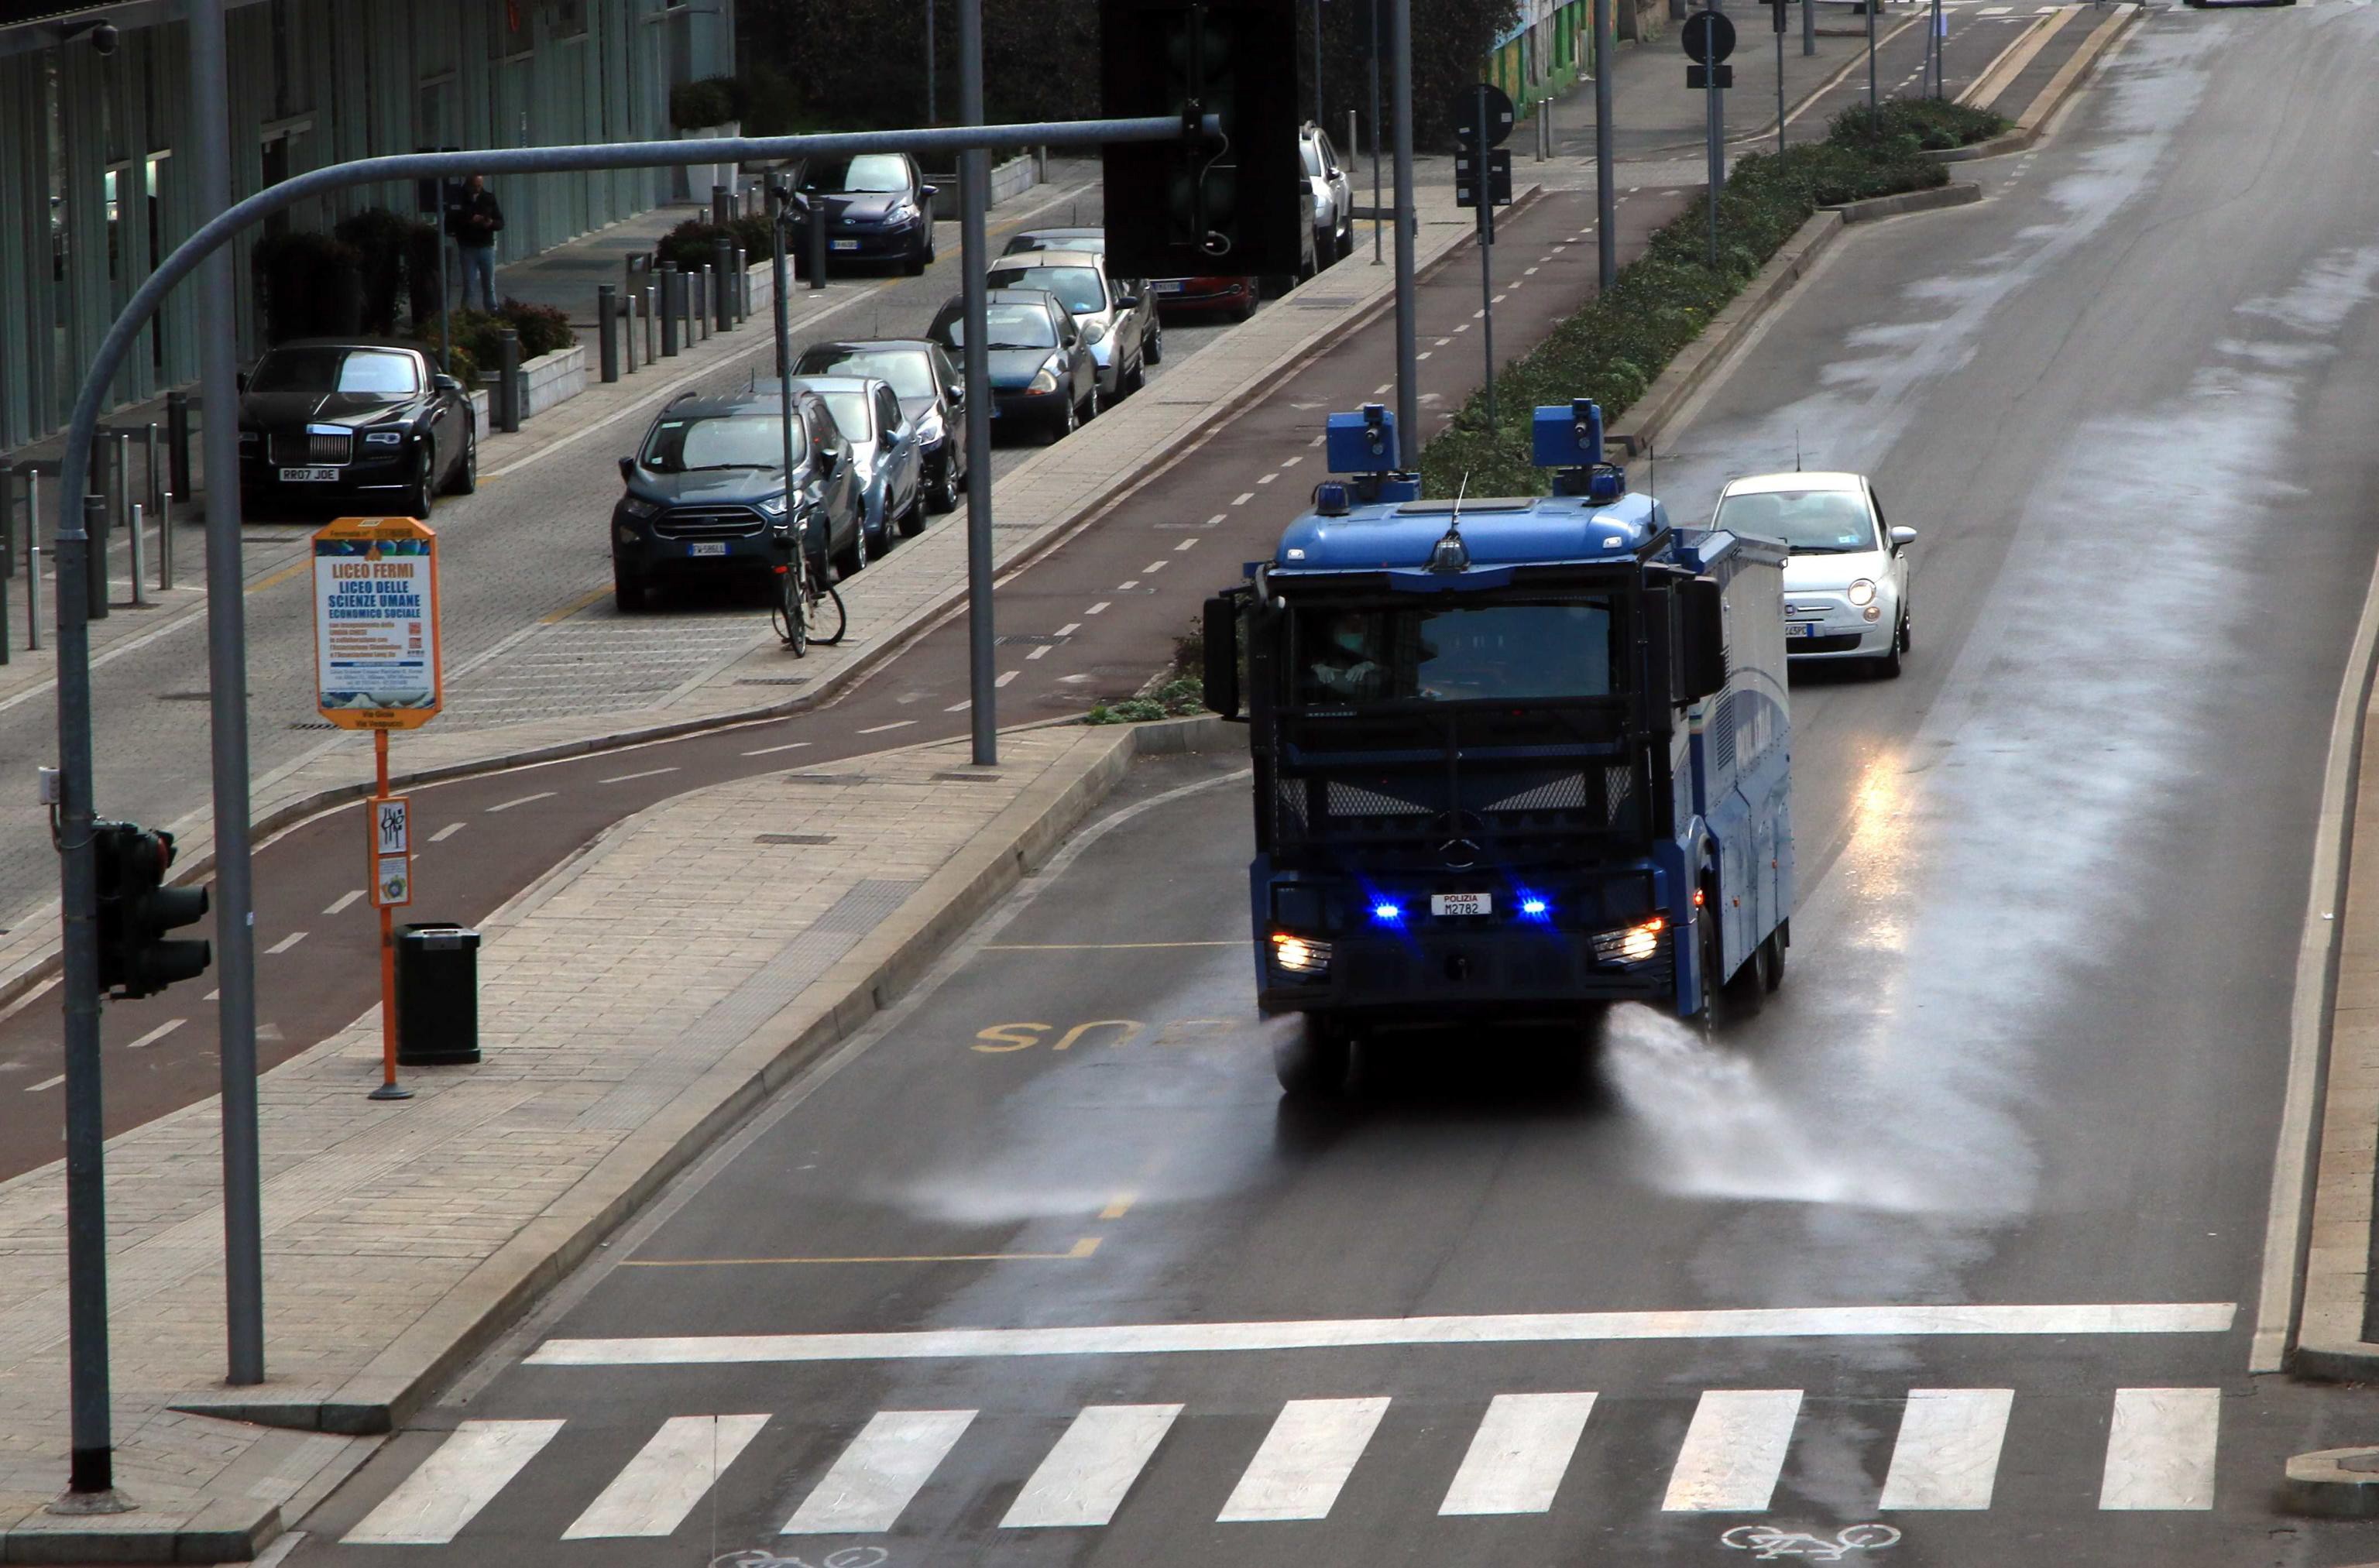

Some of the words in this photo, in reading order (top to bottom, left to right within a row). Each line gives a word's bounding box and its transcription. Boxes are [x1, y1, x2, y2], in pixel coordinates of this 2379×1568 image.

[283, 469, 311, 479] RR07
[314, 469, 335, 479] JOE
[332, 563, 370, 578] LICEO
[373, 563, 414, 578] FERMI
[339, 581, 372, 594] LICEO
[376, 581, 408, 593] DELLE
[328, 594, 376, 608] SCIENZE
[379, 594, 421, 607] UMANE
[329, 609, 382, 619] ECONOMICO
[384, 609, 421, 618] SOCIALE
[1444, 894, 1478, 903] POLIZIA
[1445, 904, 1478, 915] M2782
